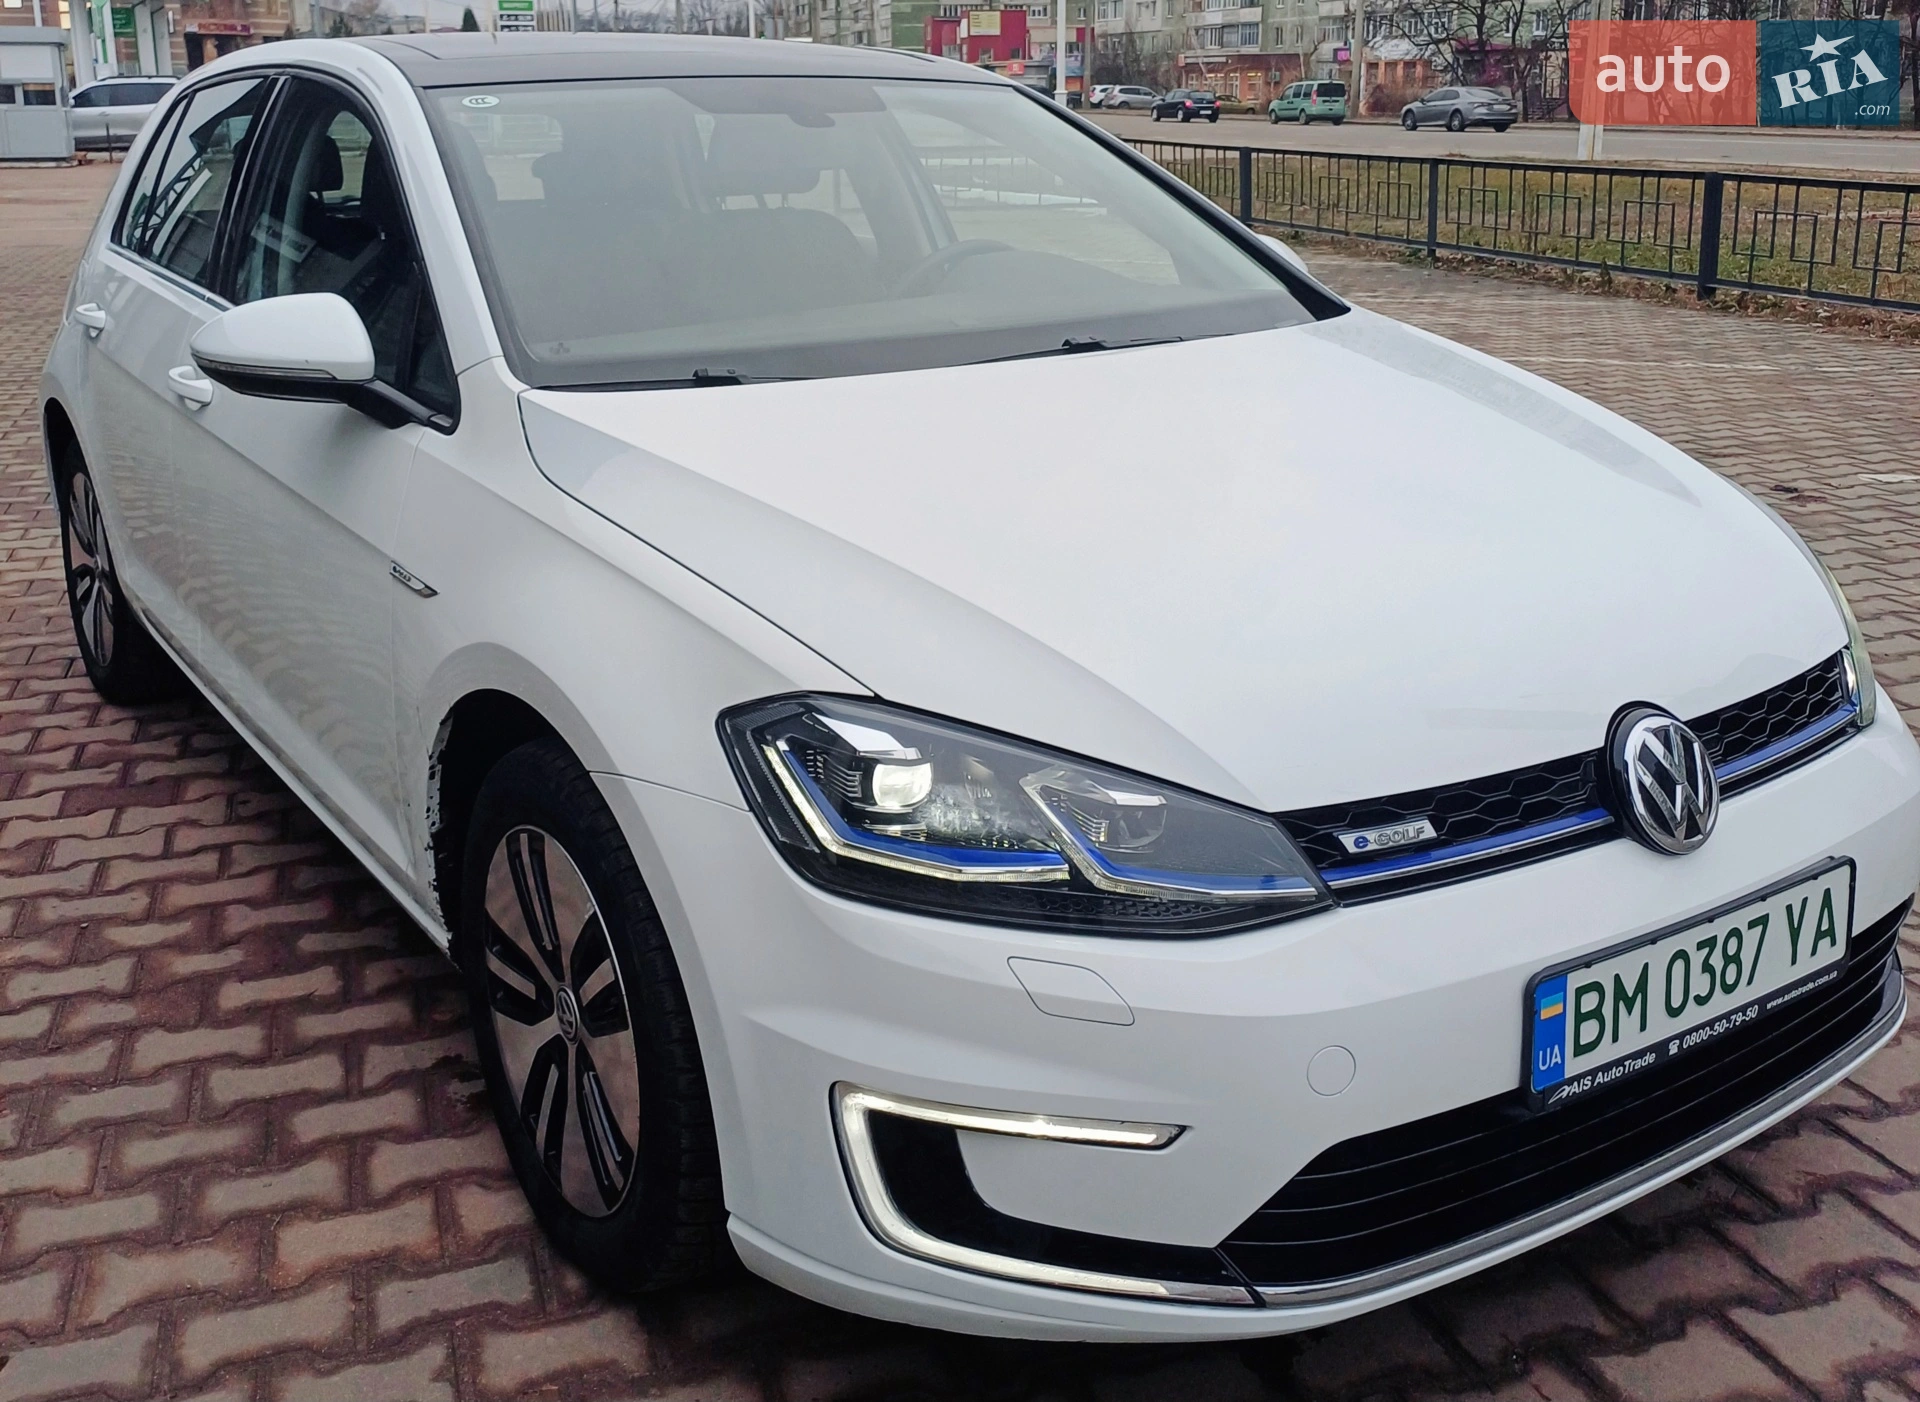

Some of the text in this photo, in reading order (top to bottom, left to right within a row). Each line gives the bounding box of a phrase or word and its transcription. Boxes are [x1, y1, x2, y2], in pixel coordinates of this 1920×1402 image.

[1353, 825, 1426, 850] e-GOLF
[1572, 887, 1838, 1058] BM 0387 YA
[1538, 1044, 1562, 1071] UA
[1569, 1075, 1592, 1096] AIS
[1593, 1051, 1656, 1087] AutoTrade
[1682, 1004, 1759, 1049] 0800-50-79-50
